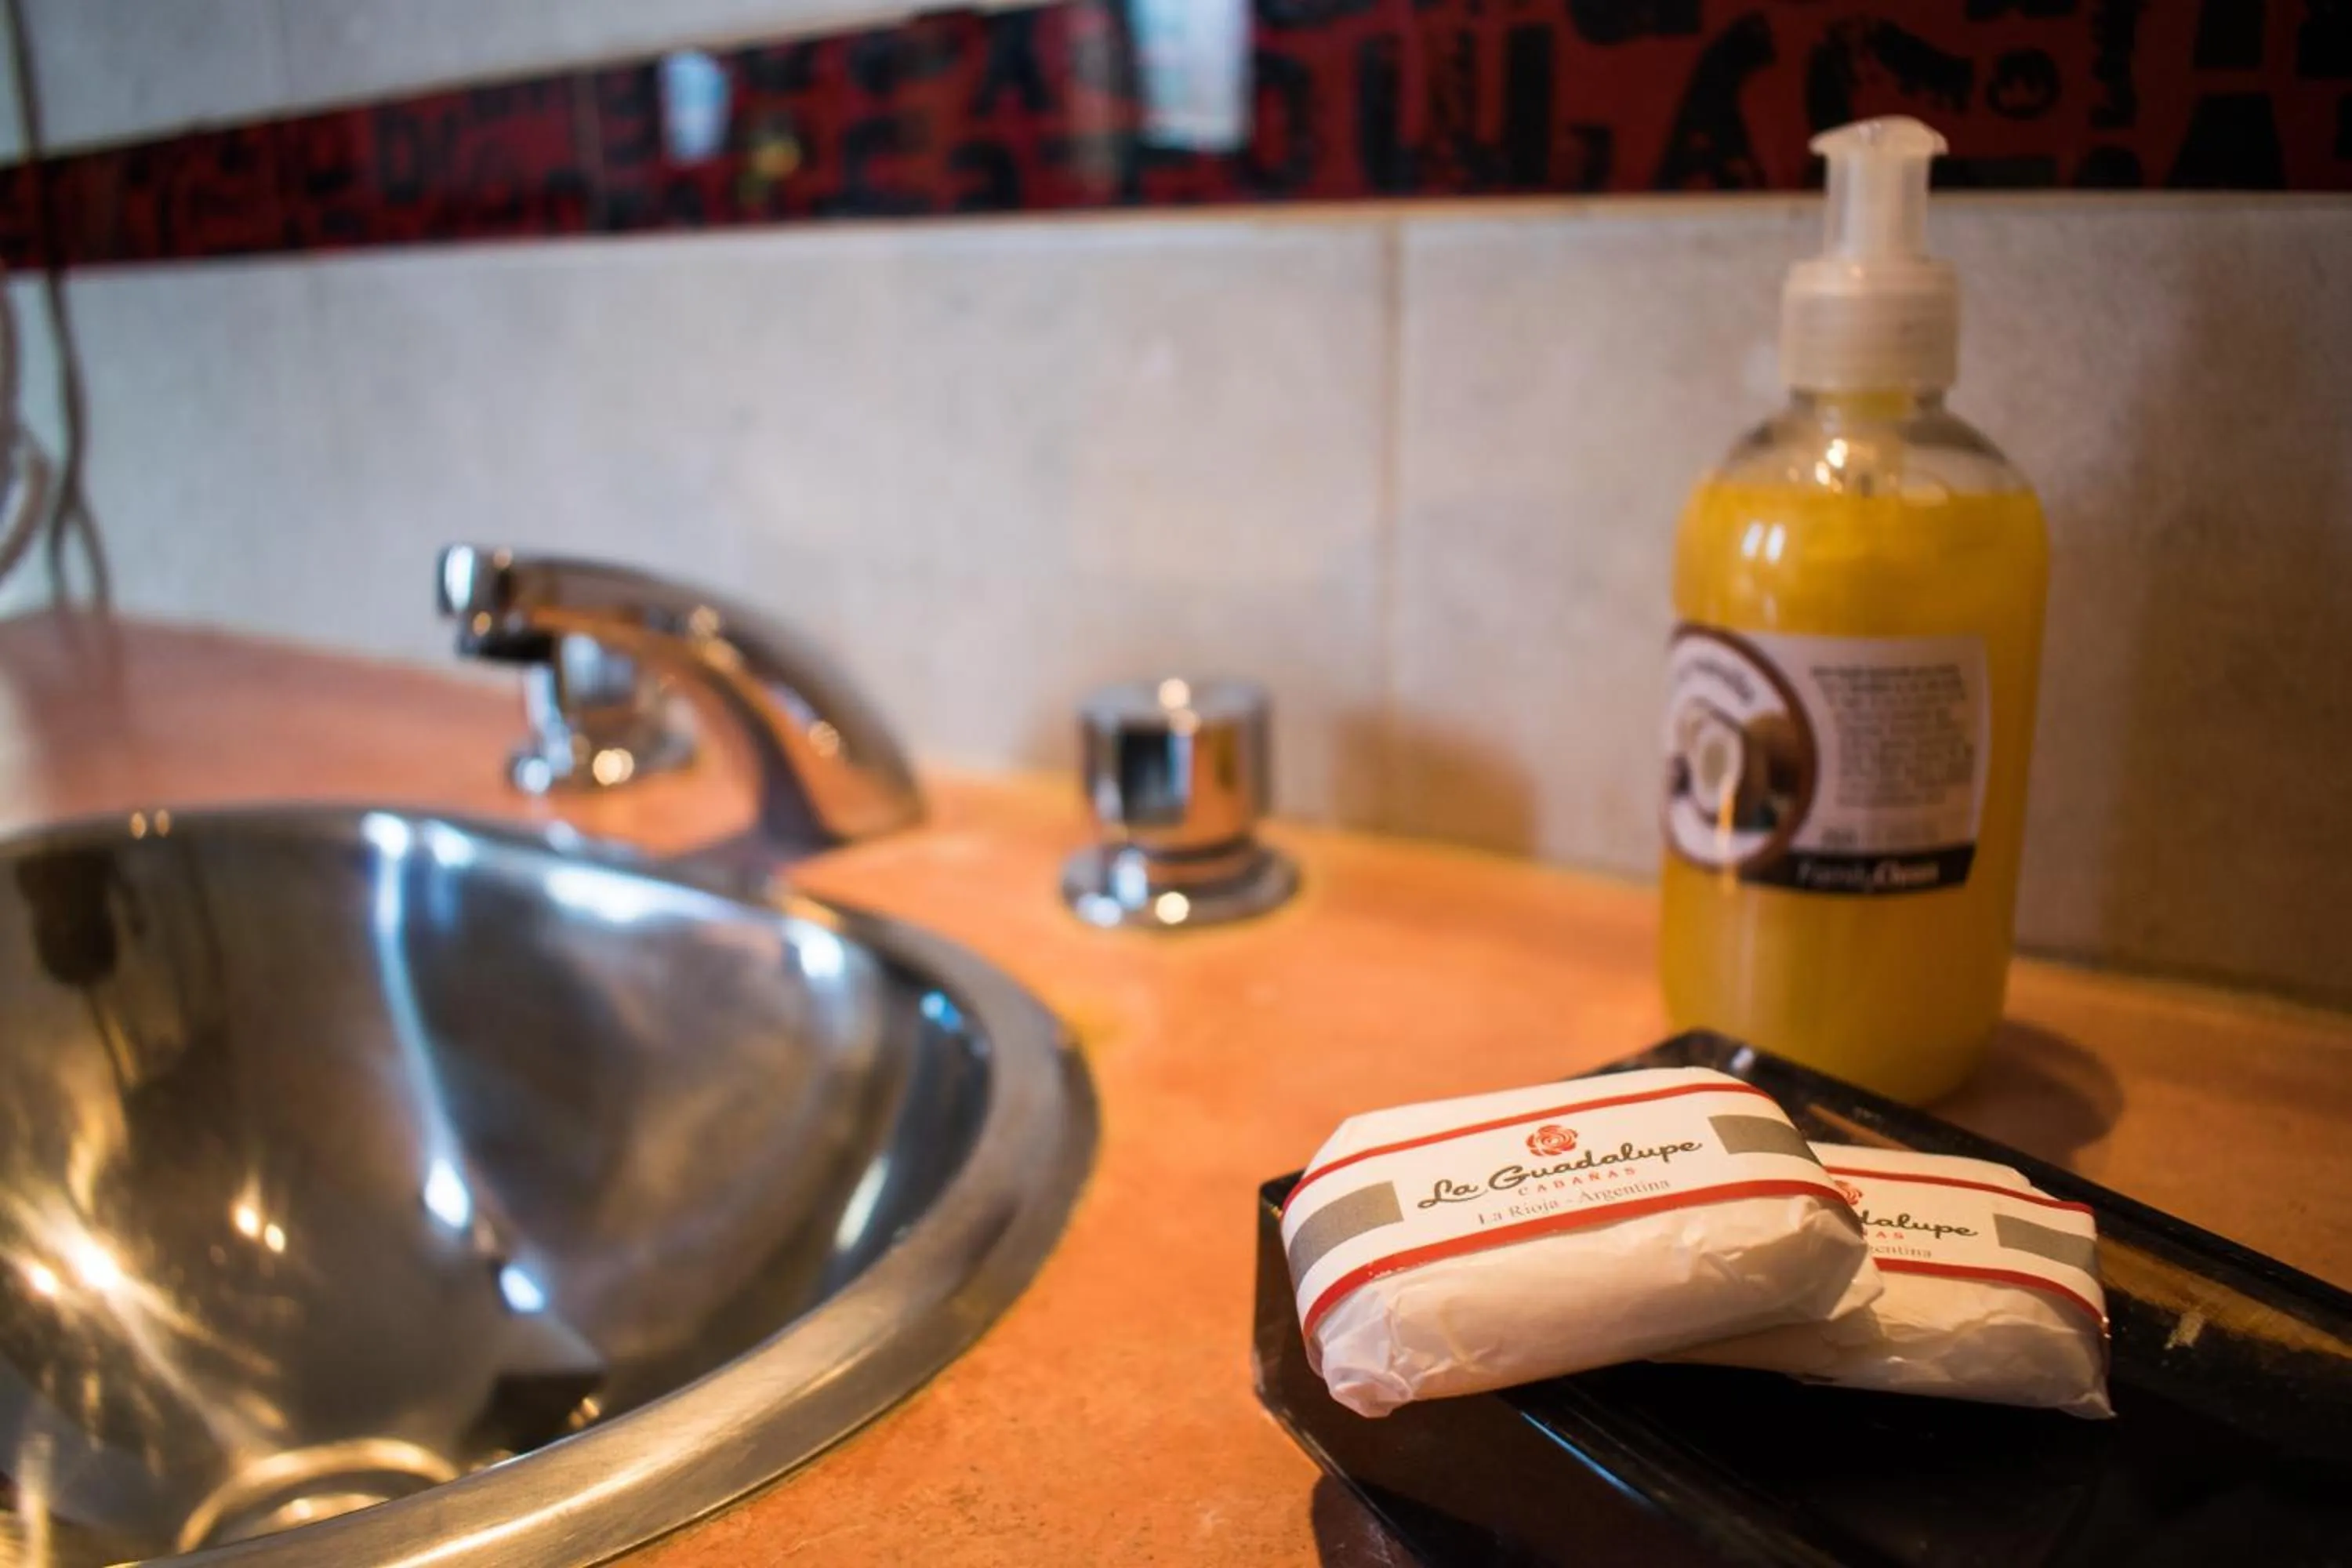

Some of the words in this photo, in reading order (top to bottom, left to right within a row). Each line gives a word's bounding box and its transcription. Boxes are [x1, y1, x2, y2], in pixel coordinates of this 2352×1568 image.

[1417, 1178, 1487, 1209] La
[1489, 1142, 1703, 1190] Guadalupe
[1477, 1212, 1503, 1225] La
[1508, 1199, 1560, 1218] Rioja
[1578, 1179, 1671, 1205] Argentina
